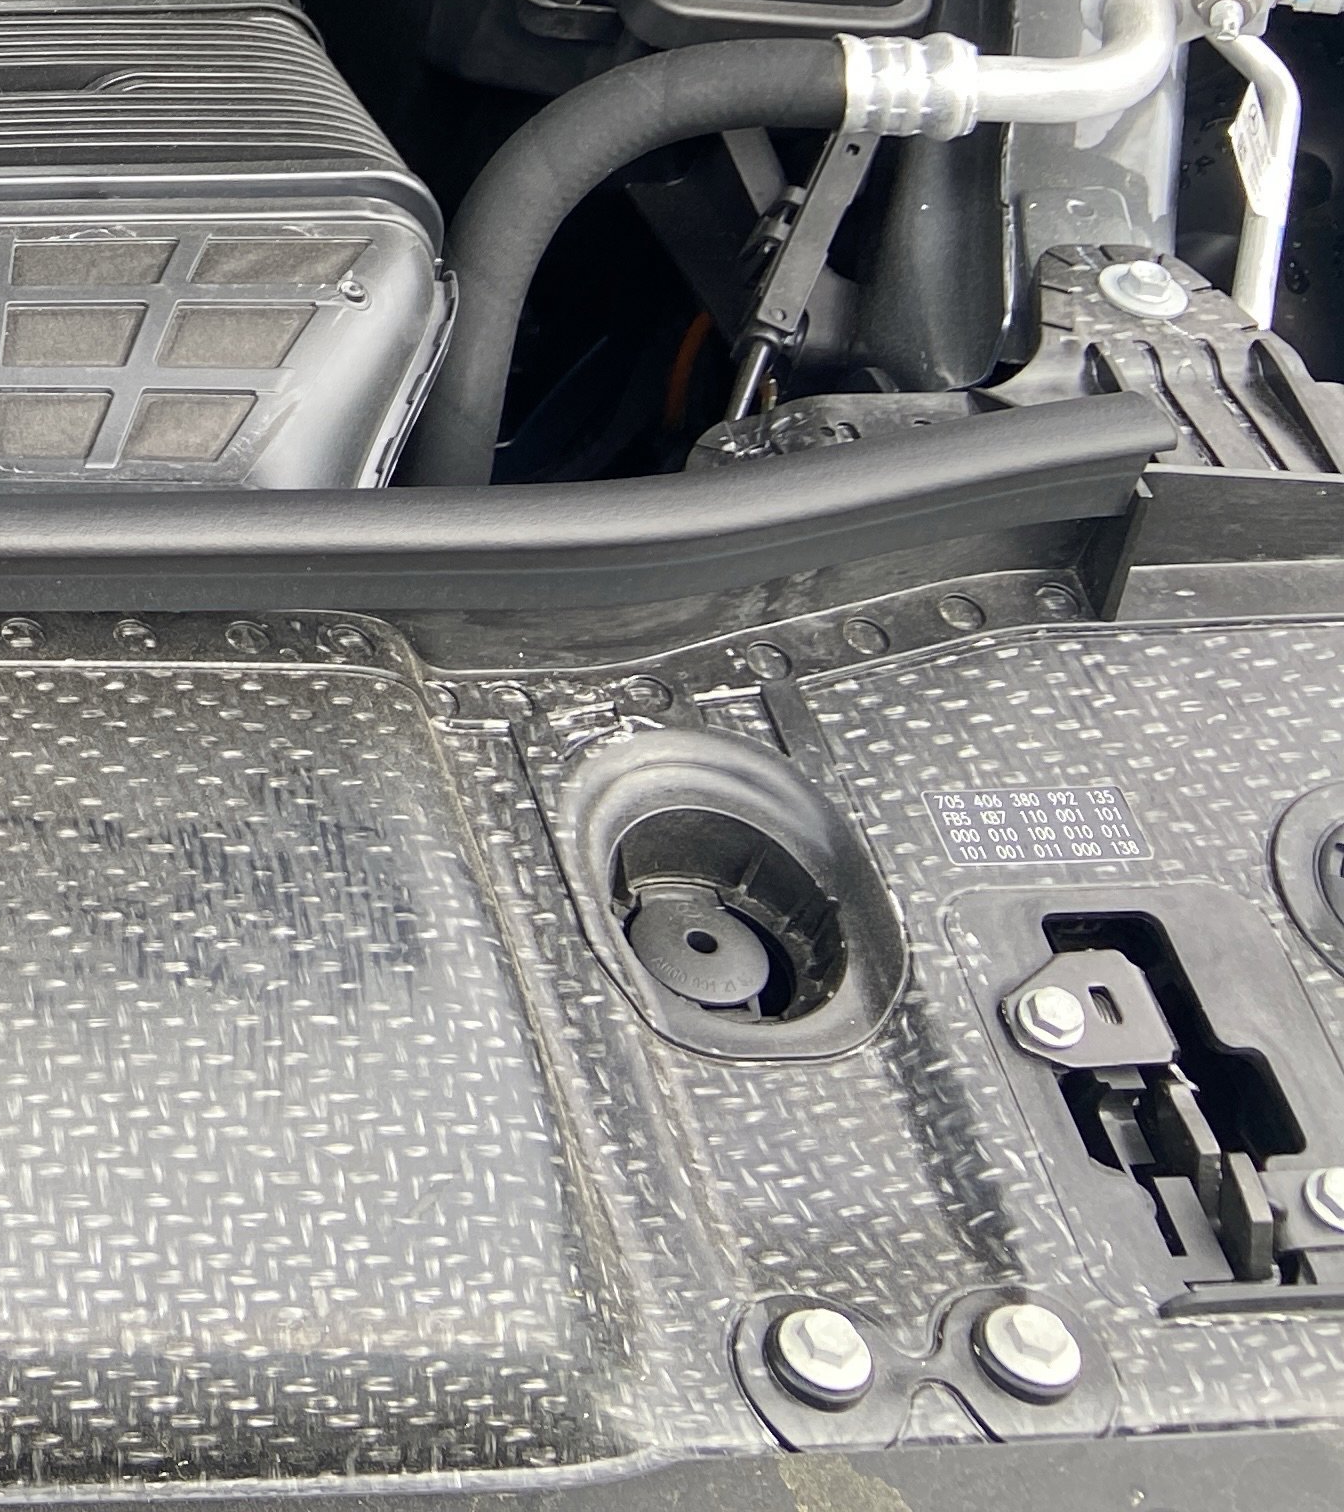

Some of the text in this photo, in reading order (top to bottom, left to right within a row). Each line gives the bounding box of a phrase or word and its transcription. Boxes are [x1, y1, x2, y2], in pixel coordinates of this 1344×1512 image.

[934, 790, 1115, 809] 705 406 380 992 135
[942, 807, 1122, 826] FB5 KB7 110 001 101
[950, 823, 1131, 843] 000 010 100 010 011
[960, 840, 1140, 860] 101 001 011 000 138
